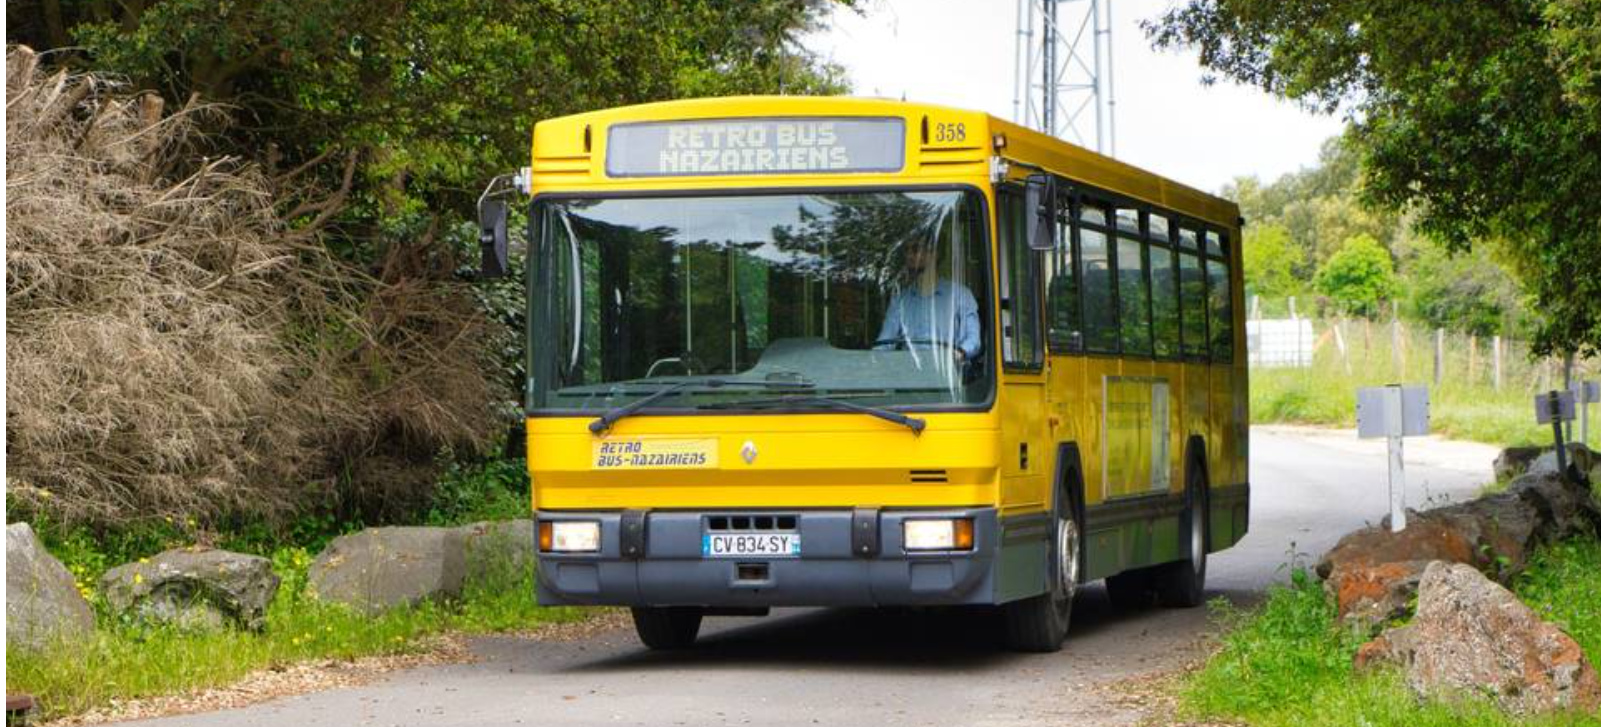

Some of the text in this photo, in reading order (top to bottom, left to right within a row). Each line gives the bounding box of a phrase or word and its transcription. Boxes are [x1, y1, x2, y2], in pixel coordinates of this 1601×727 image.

[668, 122, 836, 149] RETRO BUS
[936, 122, 966, 142] 358
[659, 147, 848, 173] NAZAIRIENS
[600, 442, 642, 453] RETRO
